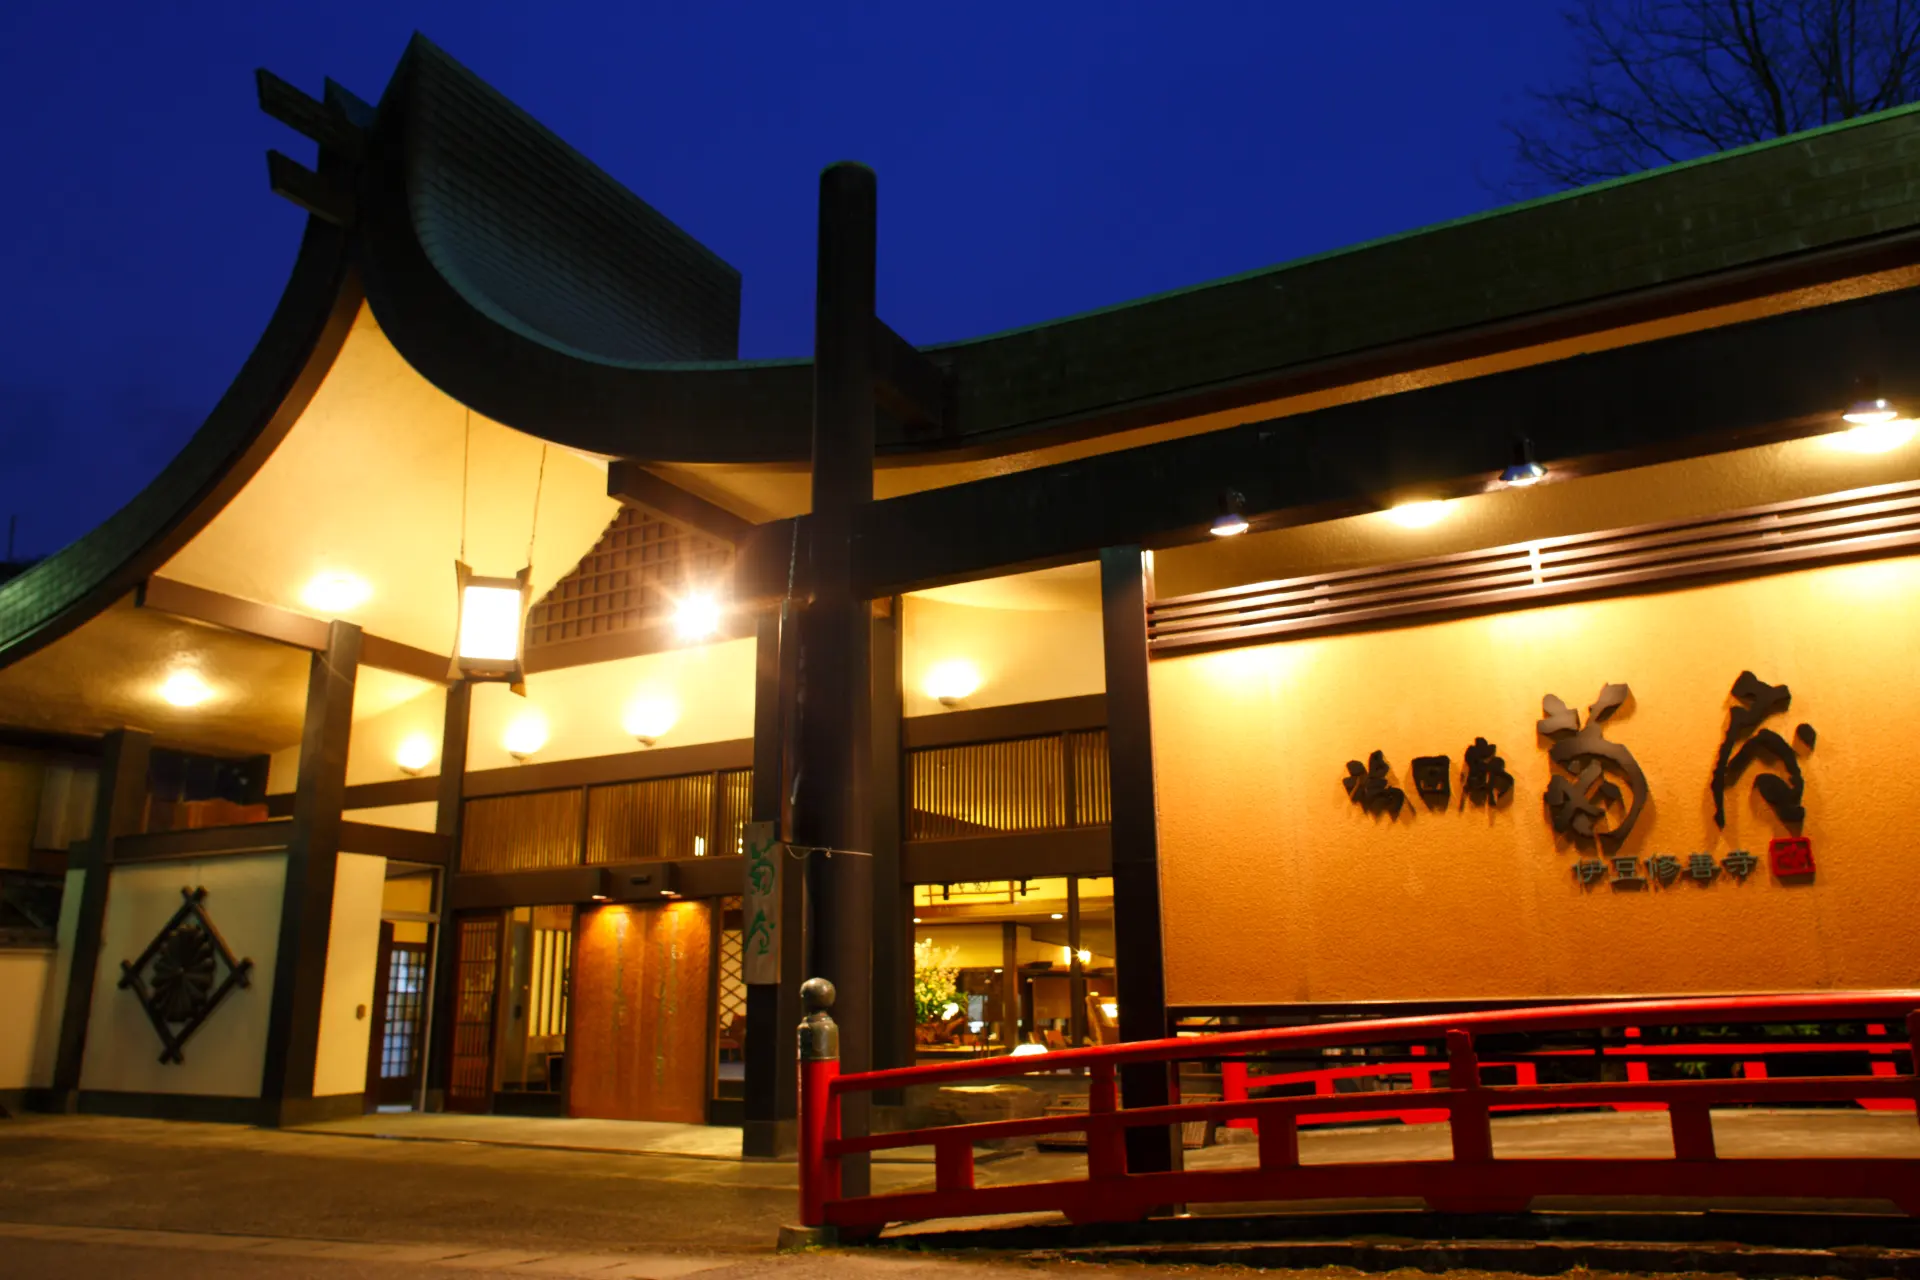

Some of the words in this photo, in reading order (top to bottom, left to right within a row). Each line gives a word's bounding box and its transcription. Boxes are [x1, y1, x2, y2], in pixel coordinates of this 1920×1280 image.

[1572, 849, 1758, 887] 伊豆修善寺
